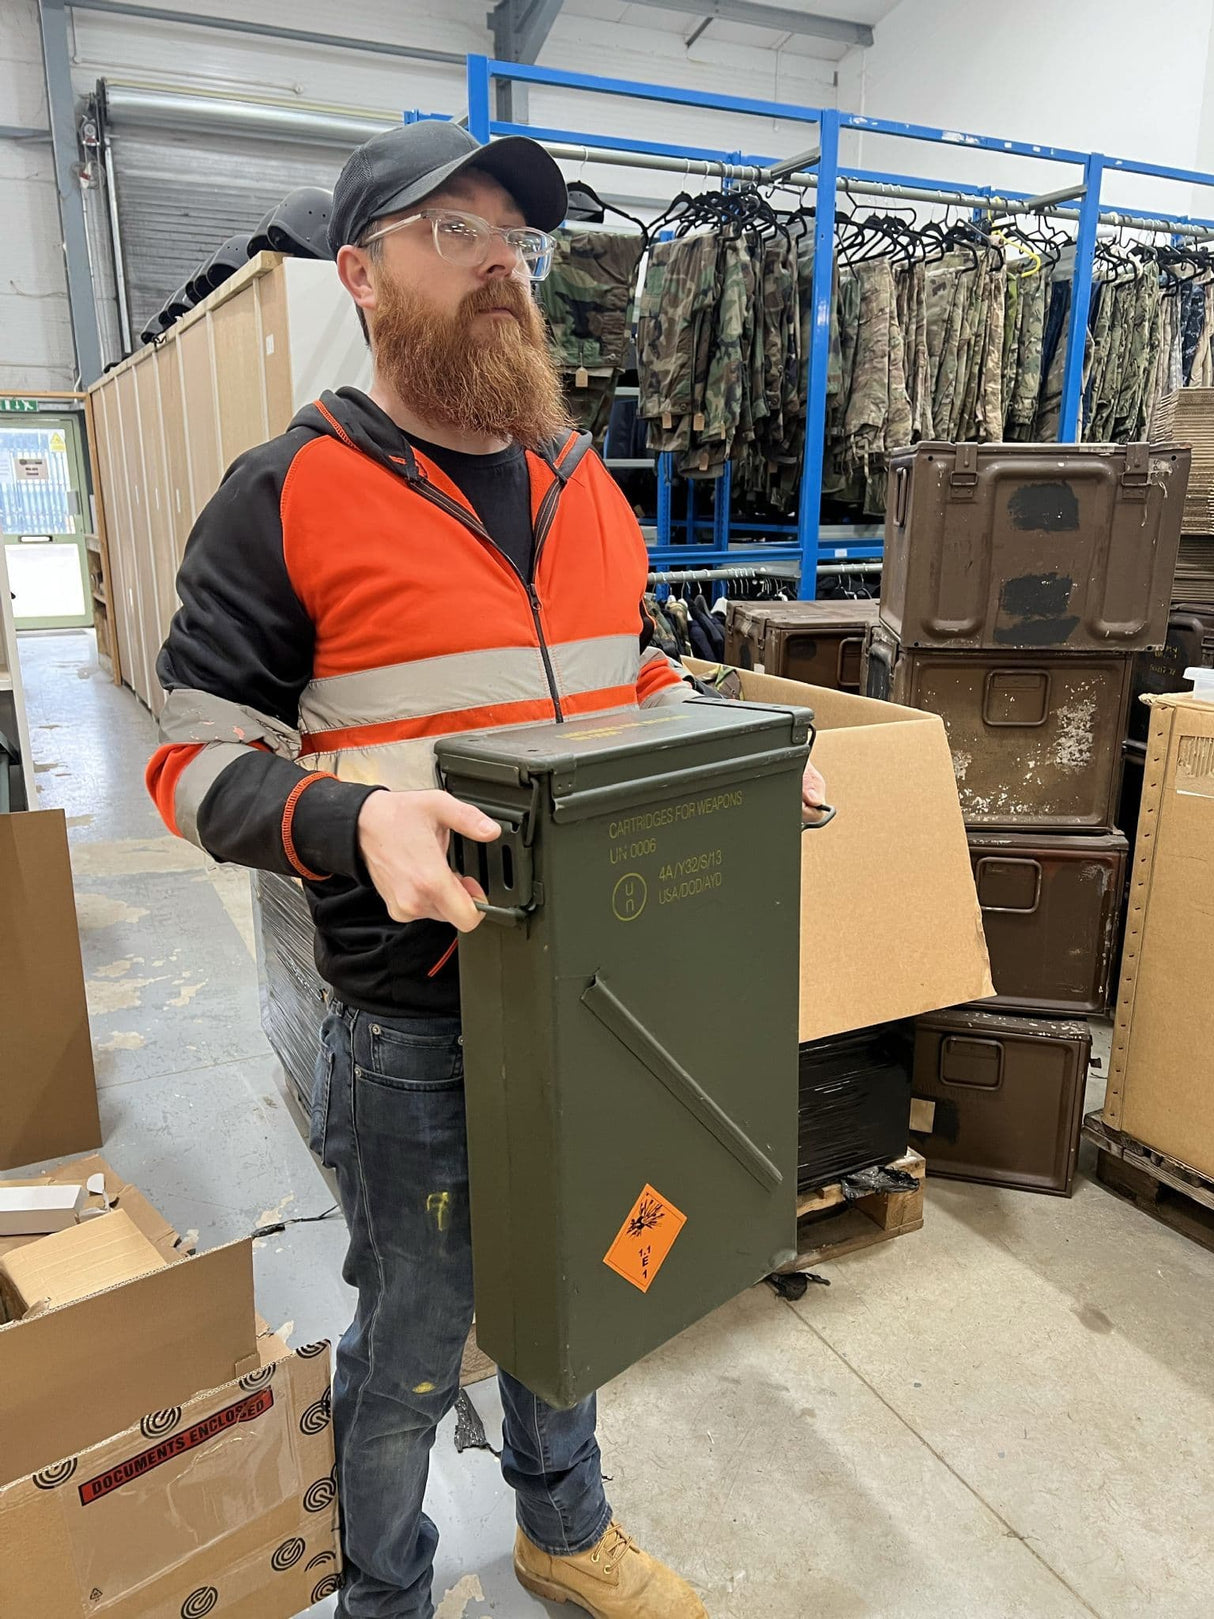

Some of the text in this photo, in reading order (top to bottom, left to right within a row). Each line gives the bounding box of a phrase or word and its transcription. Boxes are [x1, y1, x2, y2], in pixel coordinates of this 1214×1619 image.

[609, 790, 742, 839] CARTRIDGES FOR WEAPONS
[610, 838, 657, 864] UN 0006
[642, 1255, 649, 1267] E
[642, 1269, 648, 1279] 1
[92, 1400, 265, 1495] DOCUMENTS ENCLOSED
